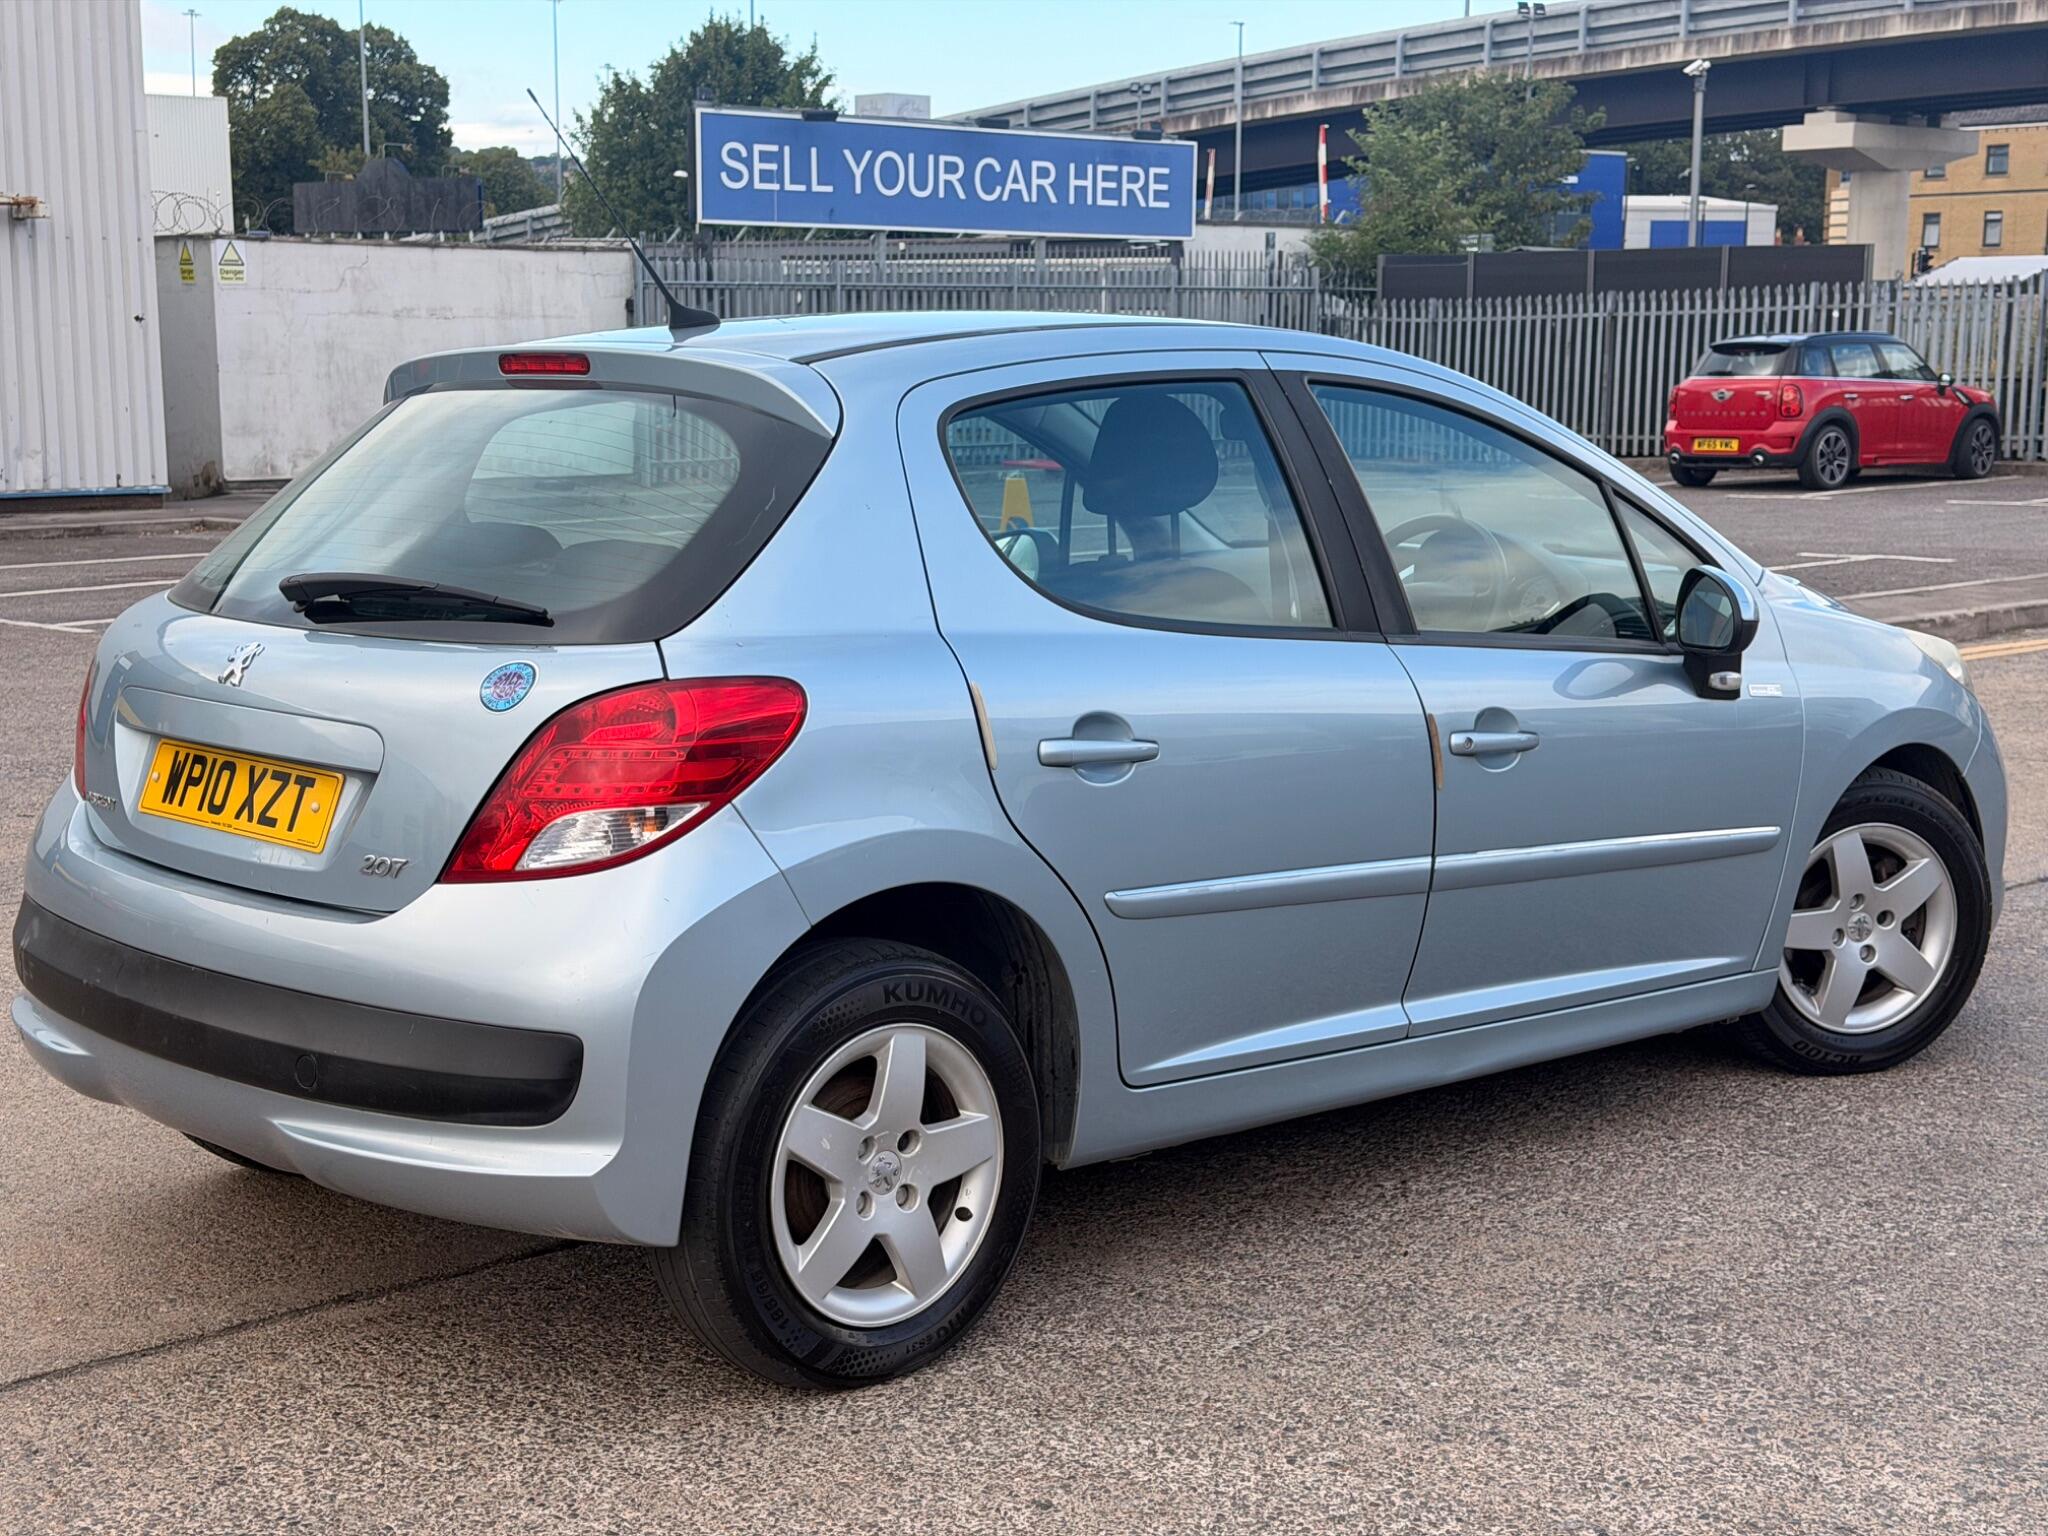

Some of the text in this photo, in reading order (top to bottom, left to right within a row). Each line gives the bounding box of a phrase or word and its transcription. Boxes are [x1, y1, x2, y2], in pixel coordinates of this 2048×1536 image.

[720, 141, 1170, 208] SELL YOUR CAR HERE
[220, 268, 244, 276] Danger
[162, 750, 316, 833] WP10 XZT
[361, 854, 409, 879] 207
[883, 981, 985, 1025] KUMHO
